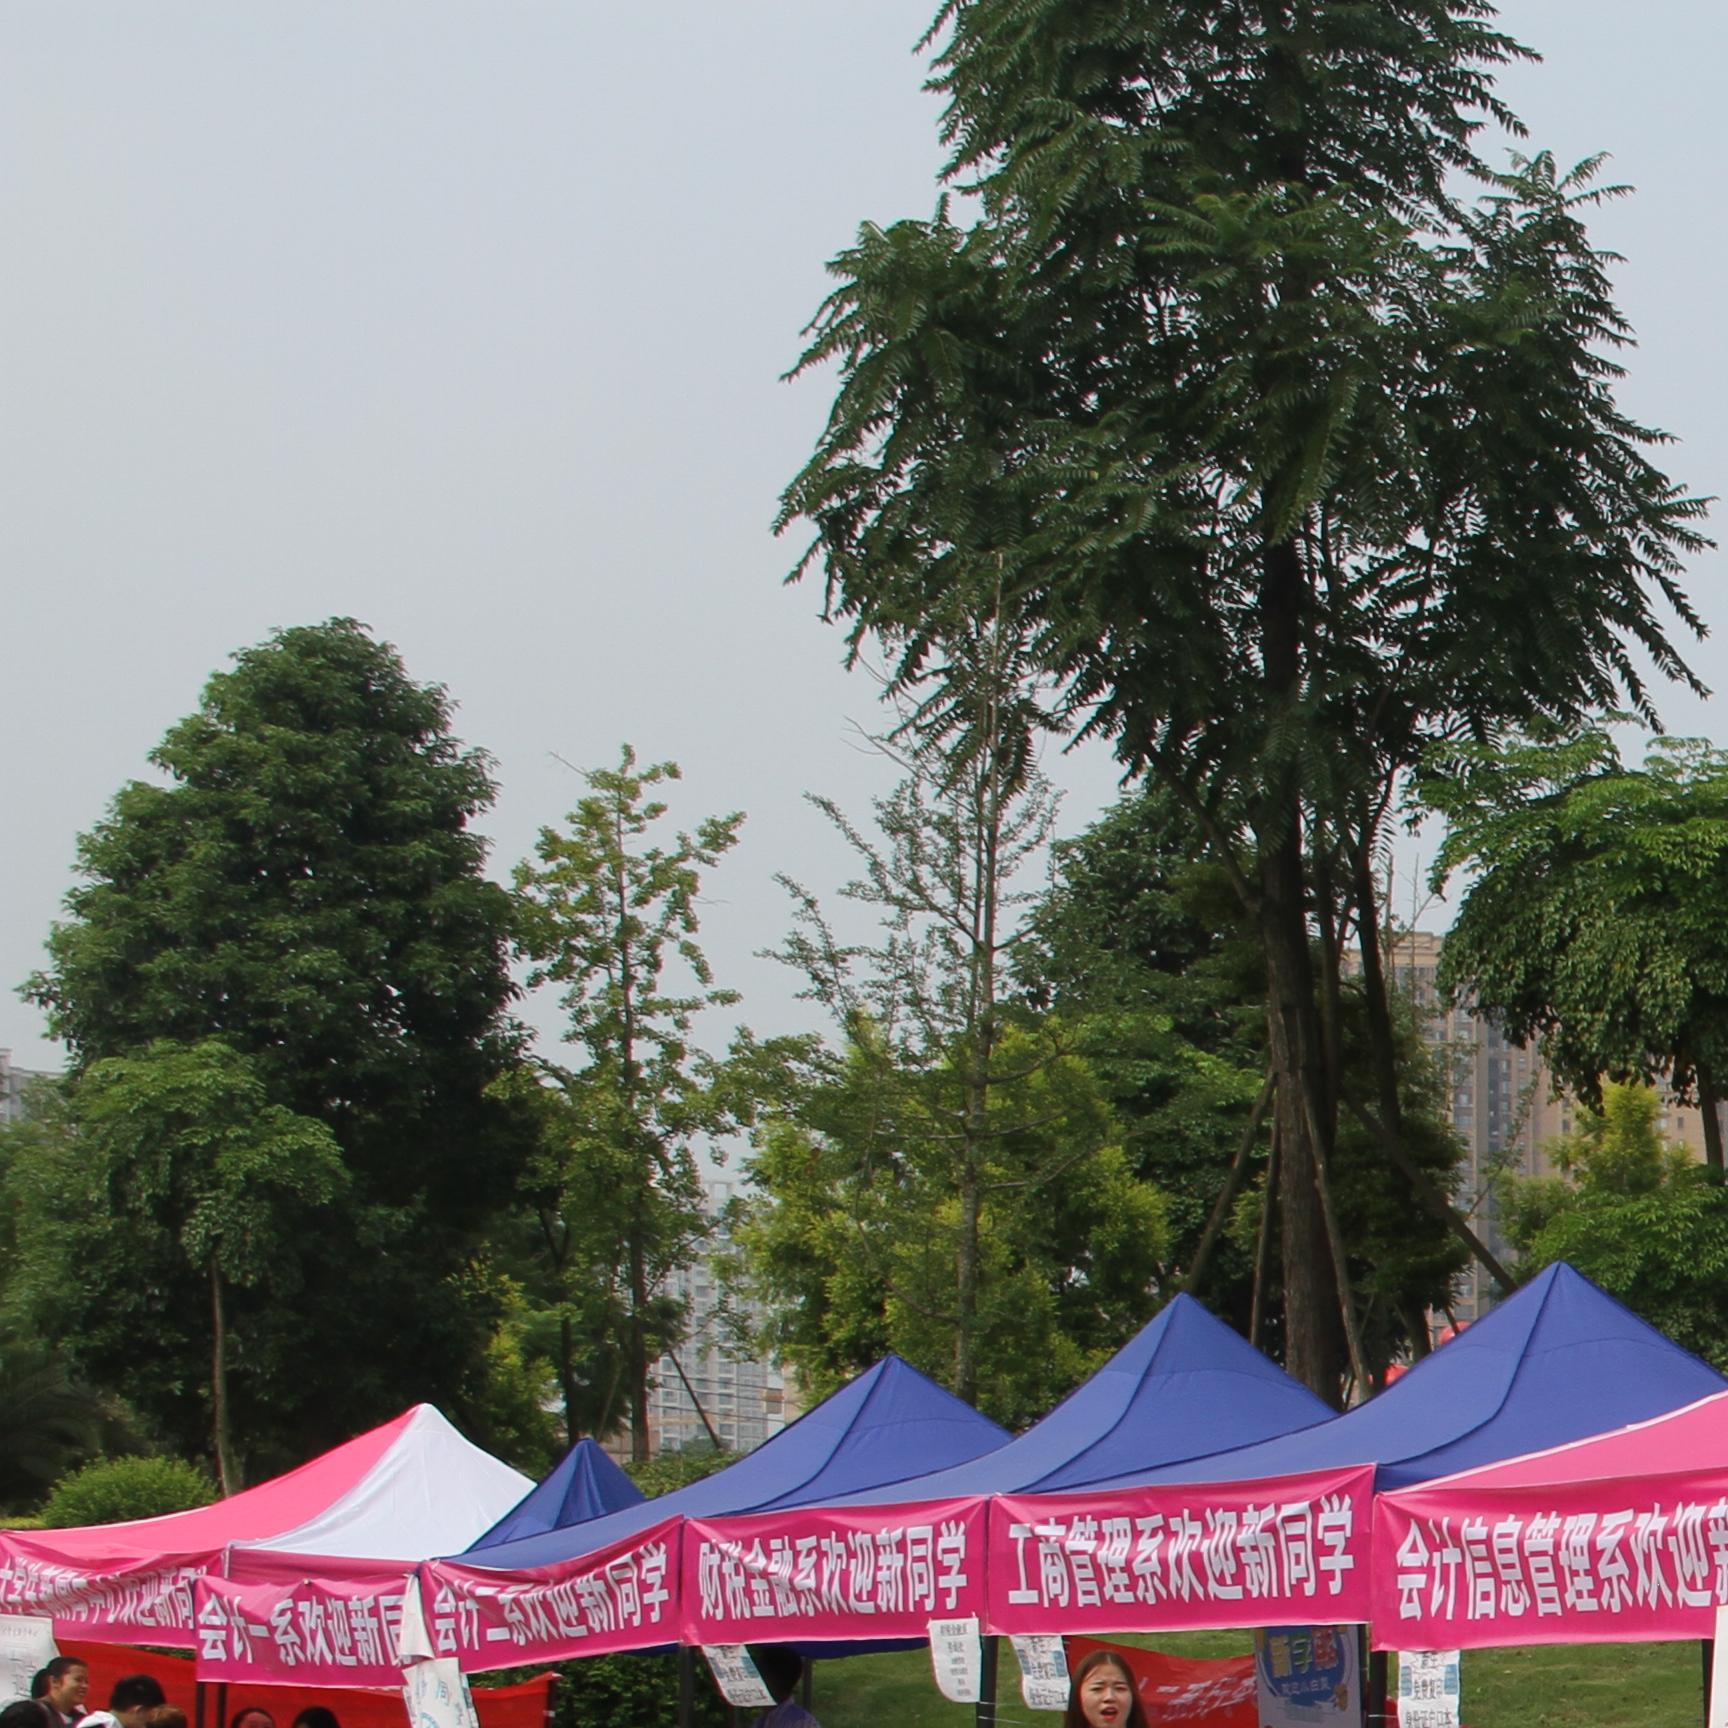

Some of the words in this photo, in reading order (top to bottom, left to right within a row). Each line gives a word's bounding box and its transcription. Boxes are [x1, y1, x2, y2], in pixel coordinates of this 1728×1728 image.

[434, 1542, 669, 1652] 会计二系欢迎新同学
[699, 1520, 968, 1621] 财税金融系欢迎新同学
[1008, 1494, 1355, 1607] 工商管理系欢迎新同学
